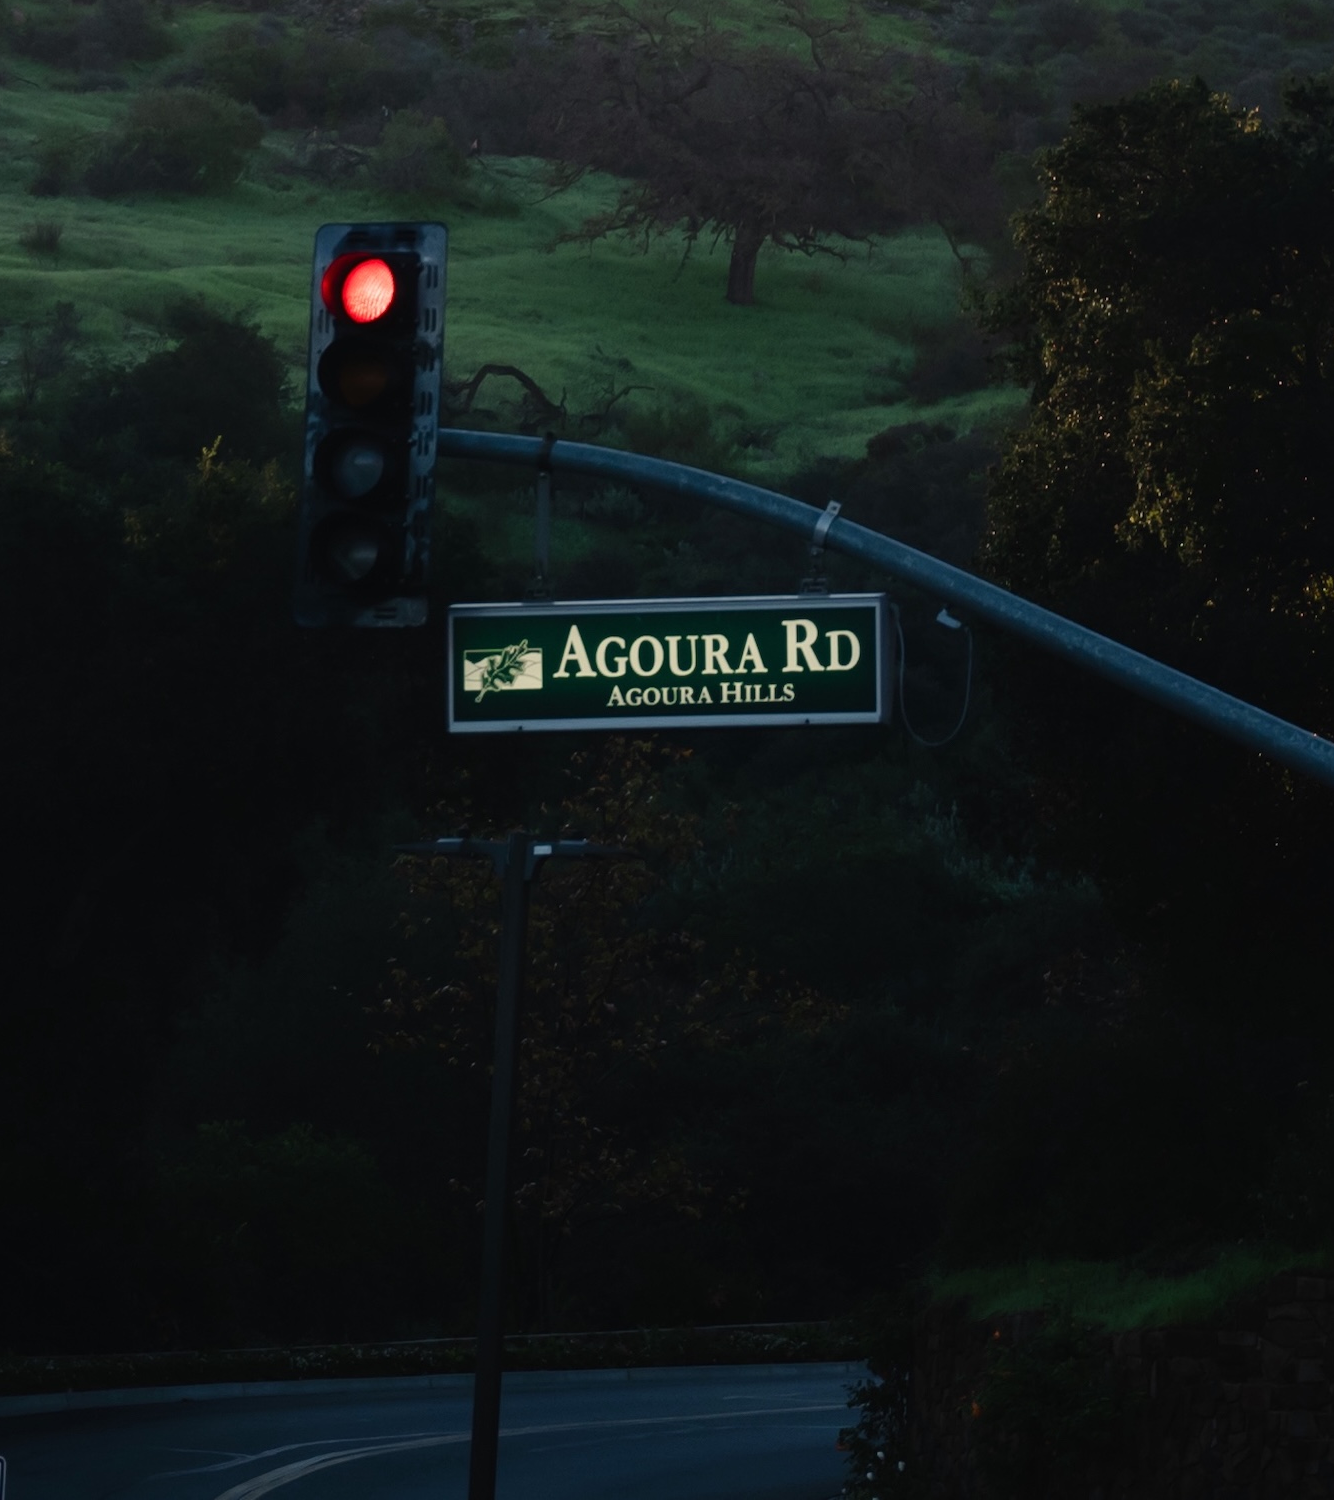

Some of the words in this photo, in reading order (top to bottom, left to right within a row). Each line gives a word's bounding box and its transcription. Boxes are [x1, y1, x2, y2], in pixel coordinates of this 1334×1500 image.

[552, 624, 769, 679] AGOURA
[780, 618, 861, 674] RD
[605, 684, 714, 708] AGOURA
[720, 681, 796, 704] HILLS
